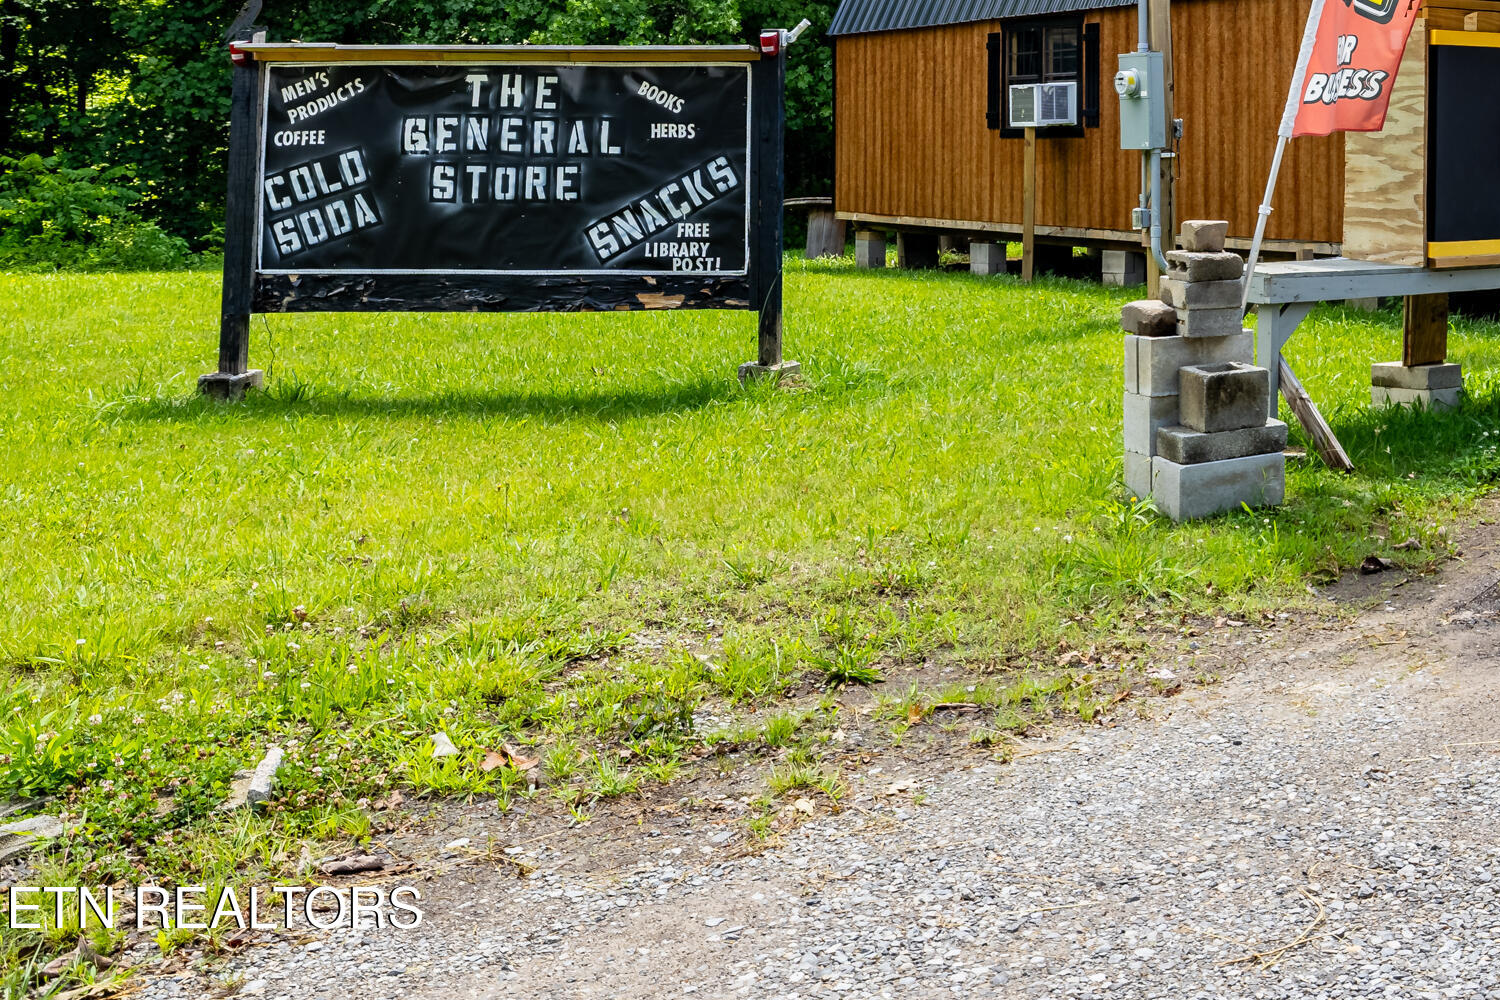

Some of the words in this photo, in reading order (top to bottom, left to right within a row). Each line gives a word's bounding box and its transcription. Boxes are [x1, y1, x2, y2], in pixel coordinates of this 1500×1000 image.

[281, 72, 330, 103] MEN'S
[287, 77, 365, 124] PRODUCTS
[465, 74, 559, 109] THE
[637, 81, 685, 114] BOOKS
[274, 130, 326, 147] COFFEE
[404, 117, 622, 155] GENERAL
[650, 123, 696, 139] HERBS
[264, 150, 367, 211] COLD
[432, 165, 578, 201] STORE
[273, 193, 378, 255] SODA
[588, 156, 738, 260] SNACKS
[677, 223, 710, 238] FREE
[644, 242, 710, 258] LIBRARY
[672, 257, 721, 272] POST!
